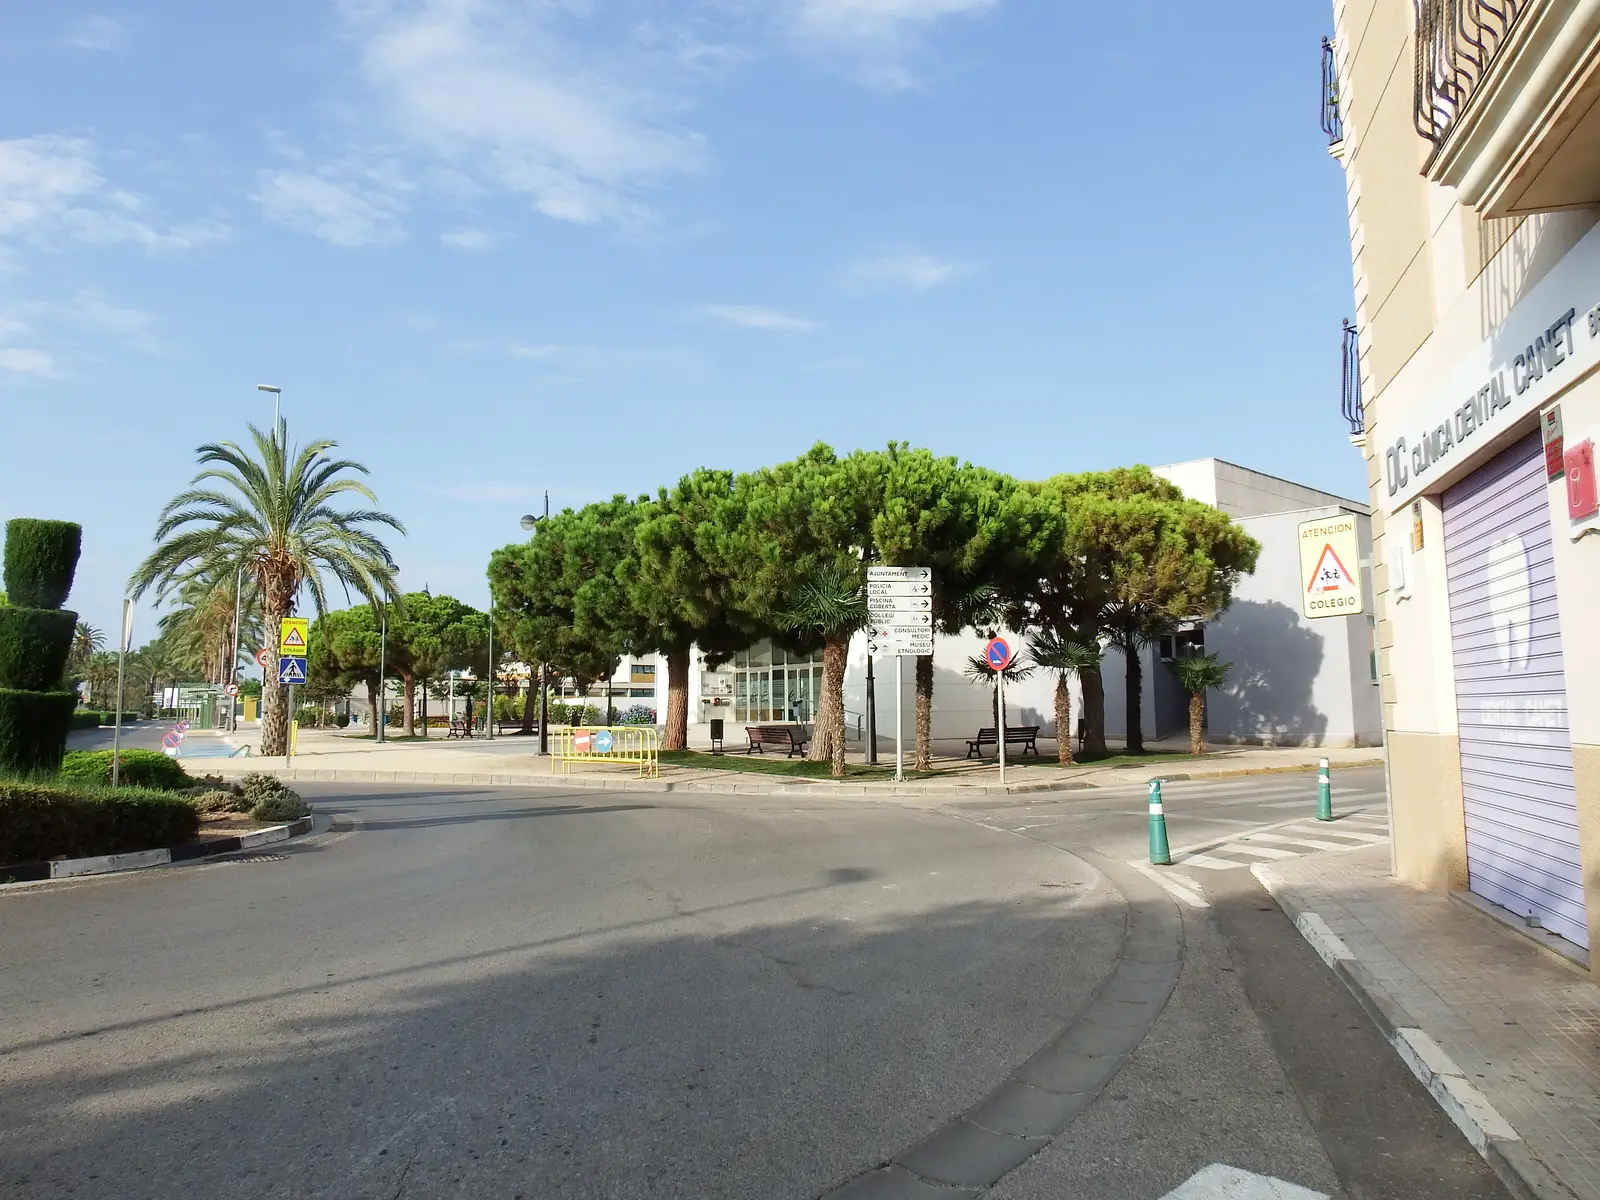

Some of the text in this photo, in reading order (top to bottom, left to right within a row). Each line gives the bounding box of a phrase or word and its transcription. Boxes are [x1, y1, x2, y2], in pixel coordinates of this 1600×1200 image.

[1385, 436, 1409, 497] DC
[1454, 371, 1511, 444] DENTAL
[1512, 307, 1575, 396] CANET
[1302, 523, 1353, 539] ATENCION
[1309, 597, 1356, 610] COLEGIO
